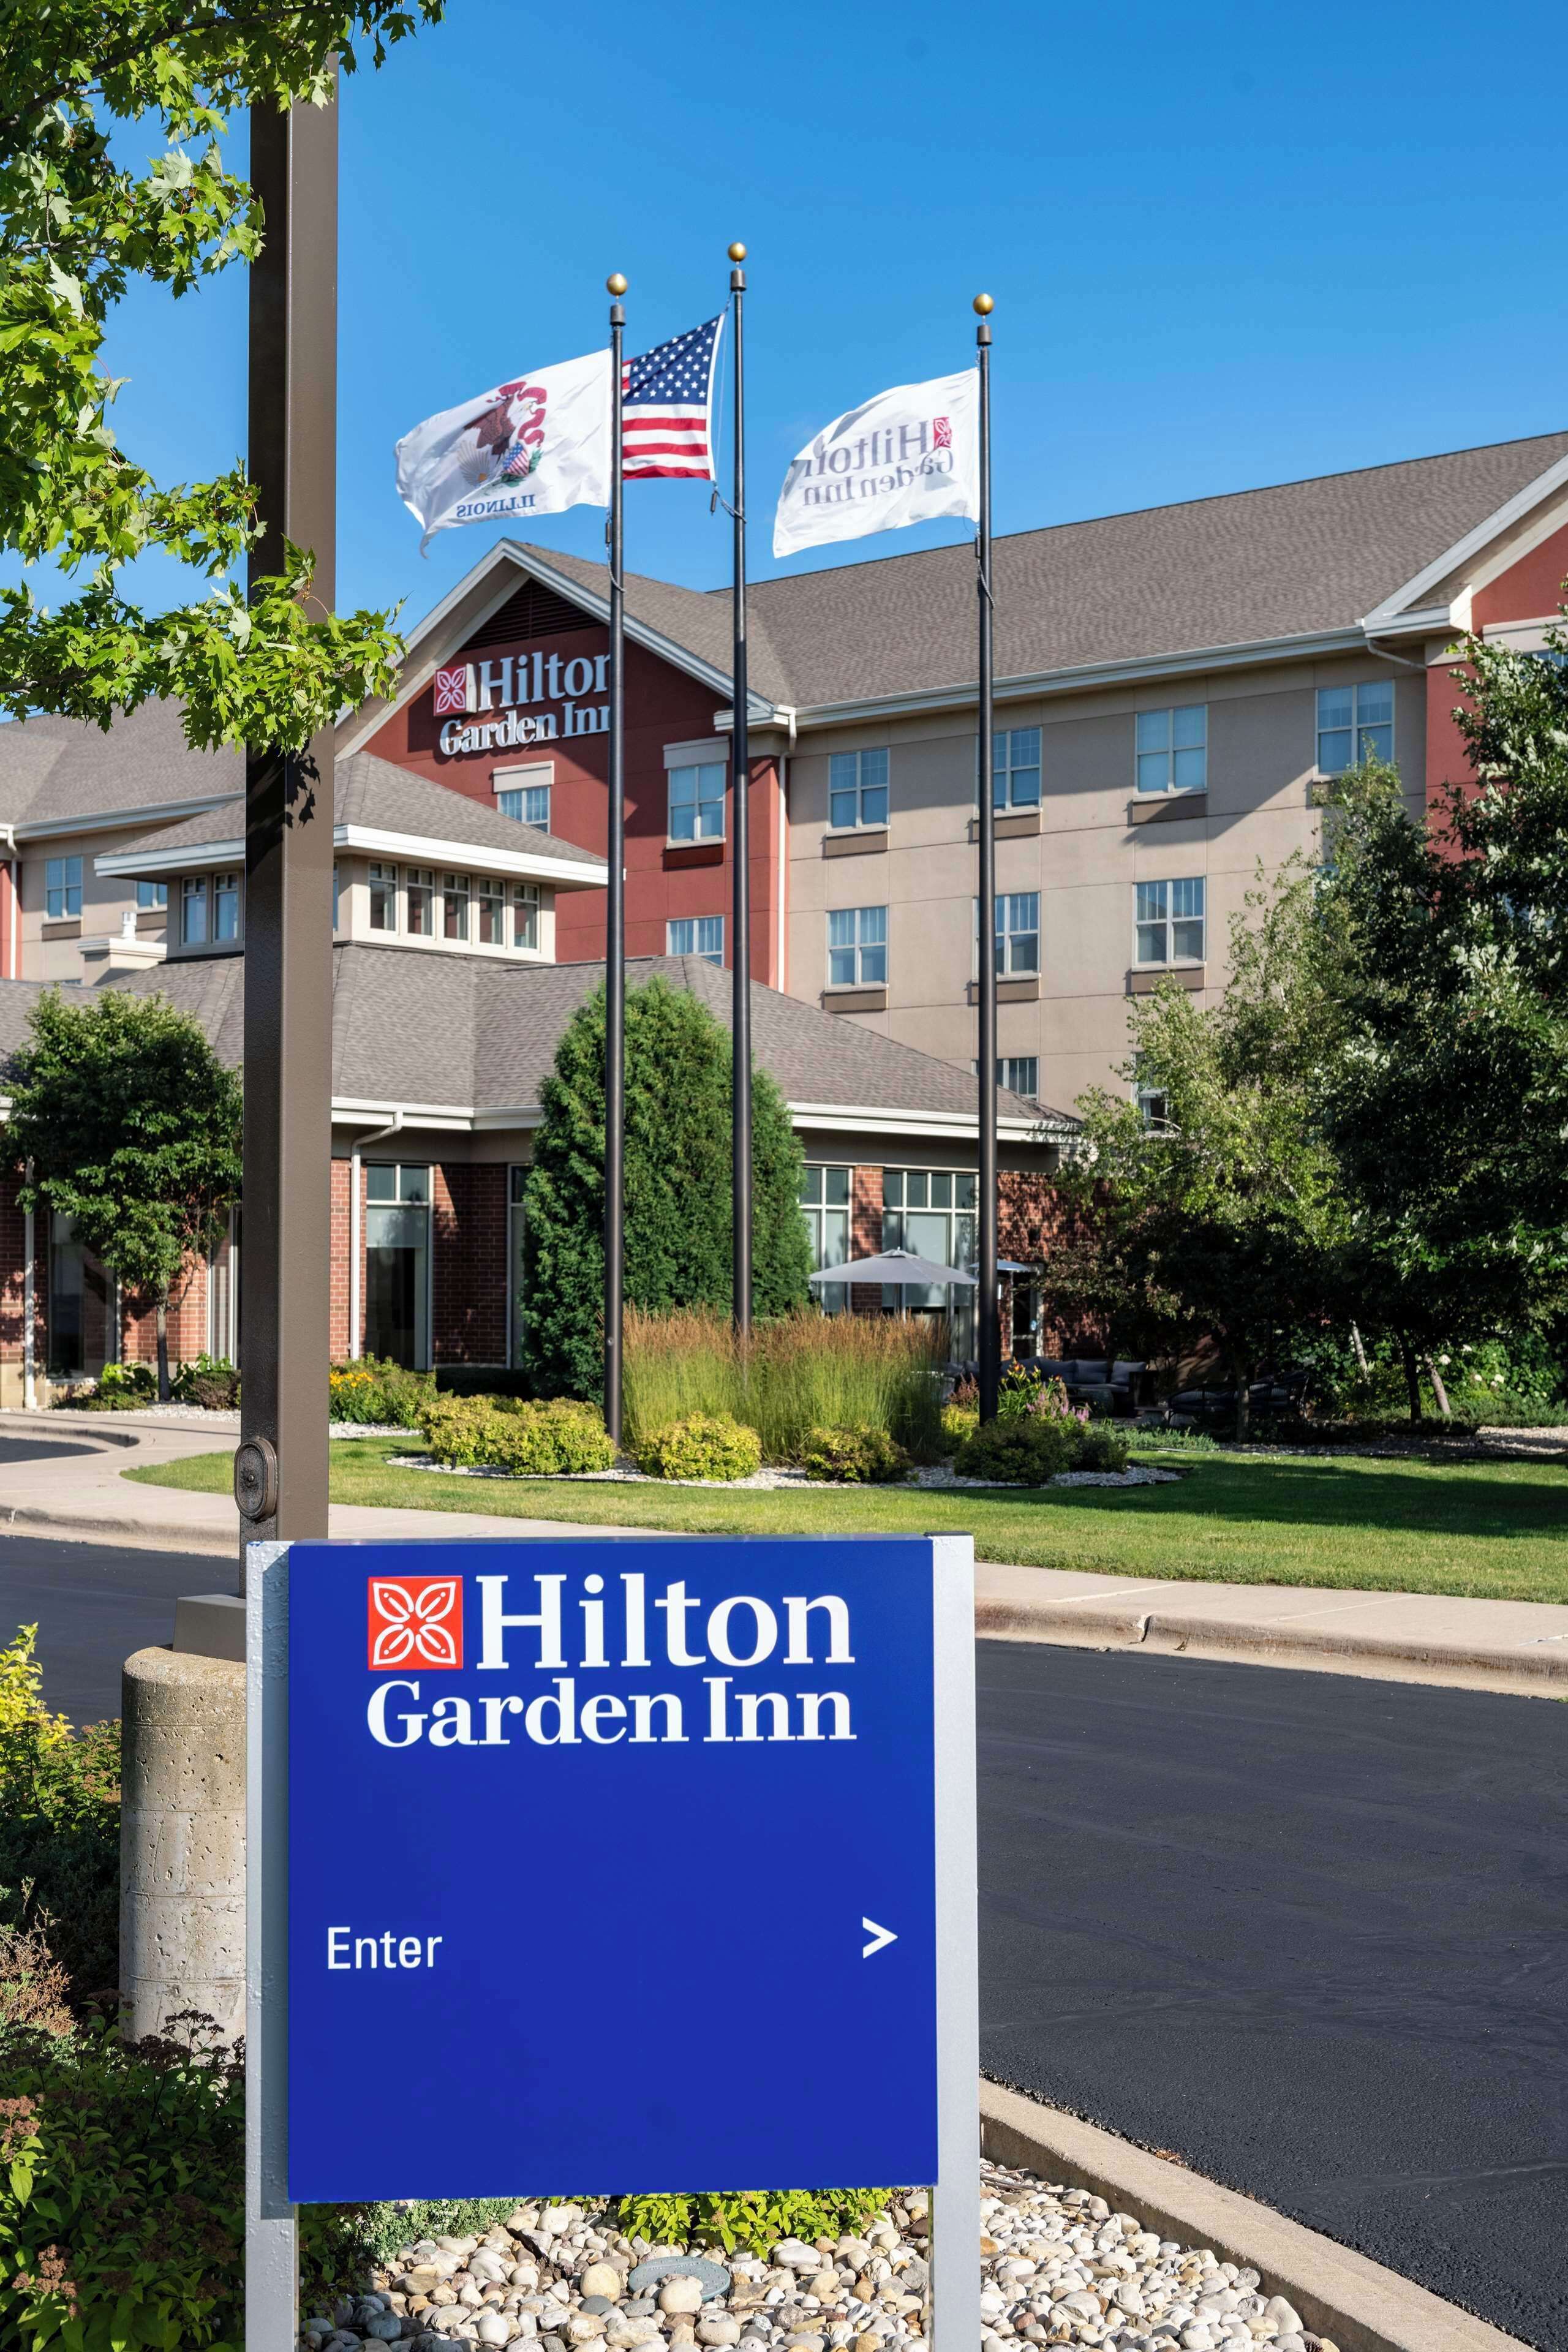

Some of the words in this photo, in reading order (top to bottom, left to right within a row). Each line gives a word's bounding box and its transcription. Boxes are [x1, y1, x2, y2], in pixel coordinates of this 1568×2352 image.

[440, 709, 559, 756] Garden
[476, 1573, 856, 1670] Hilton
[367, 1678, 690, 1747] Garden
[703, 1677, 857, 1742] Inn
[328, 1926, 443, 1970] Enter
